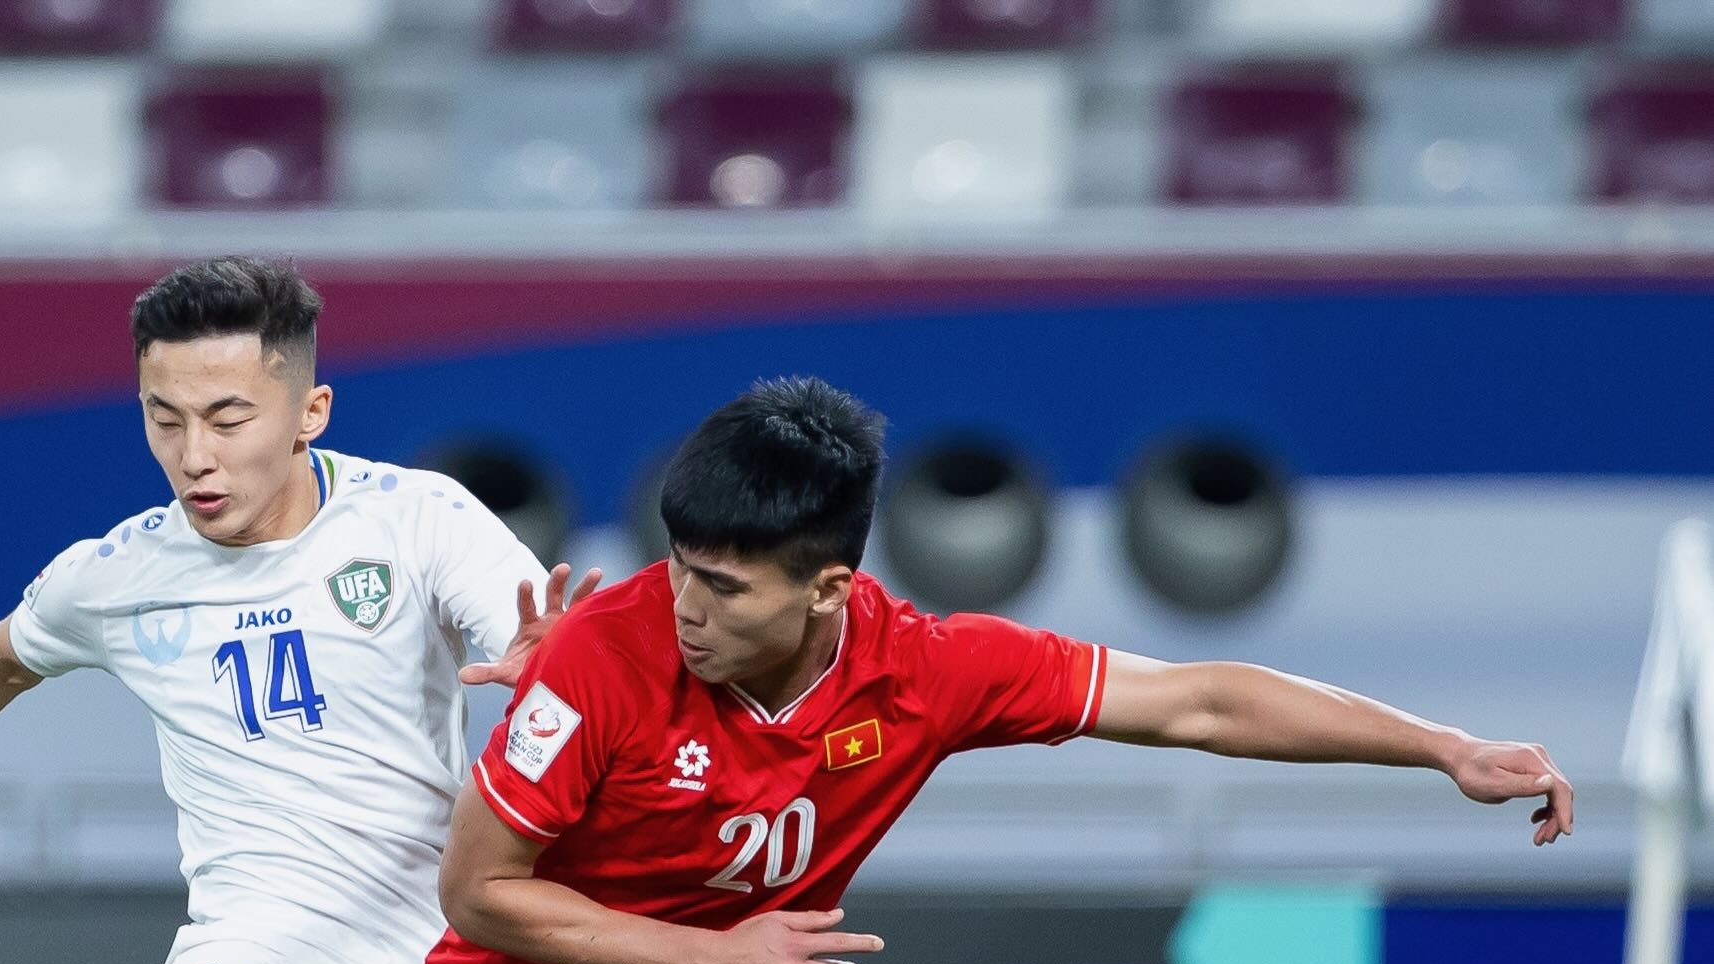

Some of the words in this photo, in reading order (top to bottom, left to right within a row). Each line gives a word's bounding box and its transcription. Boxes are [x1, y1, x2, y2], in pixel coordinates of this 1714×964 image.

[337, 571, 387, 602] UFA
[235, 608, 292, 630] JAKO
[212, 629, 327, 742] 14
[513, 729, 529, 745] AFC
[529, 741, 543, 756] U23
[526, 749, 543, 765] CUP
[704, 797, 815, 893] 20
